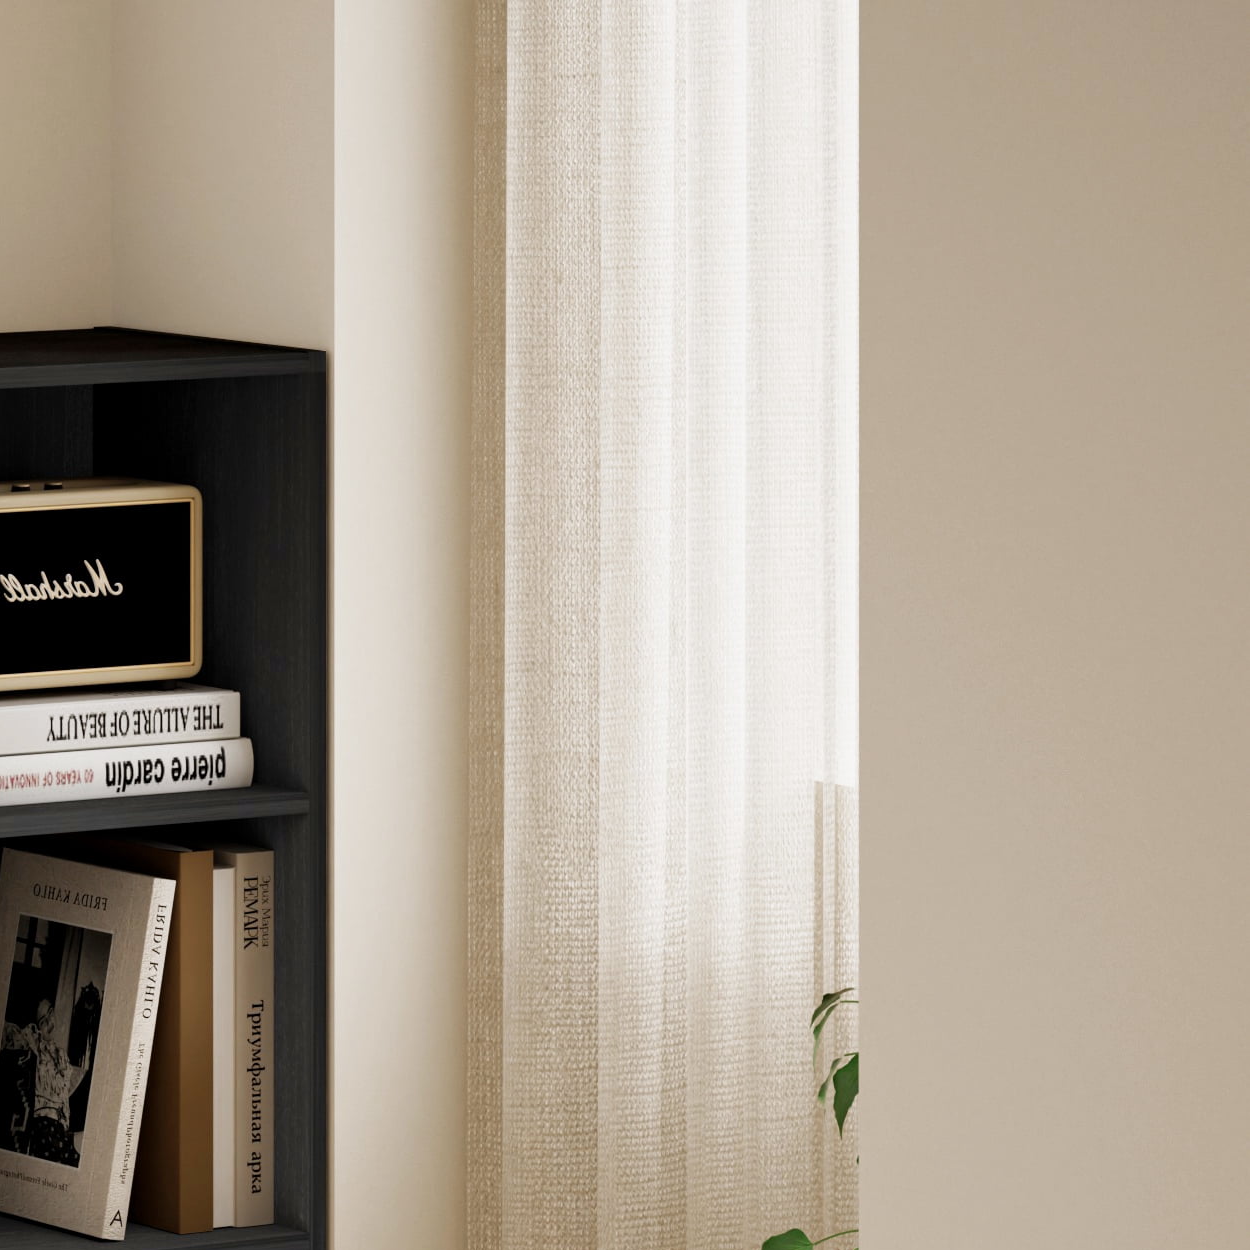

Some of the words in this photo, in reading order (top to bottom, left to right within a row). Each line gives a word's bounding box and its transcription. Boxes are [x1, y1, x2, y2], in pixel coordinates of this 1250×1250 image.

[47, 714, 106, 741] BEAUTY
[109, 711, 129, 737] OF
[133, 706, 190, 734] ALLURE
[193, 704, 223, 729] THE
[42, 772, 53, 787] OF
[56, 770, 81, 786] YEARS
[105, 759, 164, 792] cardin
[171, 747, 226, 786] pierre
[243, 877, 258, 949] РЕМАРК
[247, 1000, 265, 1143] Триумфальная
[249, 1152, 262, 1194] арка
